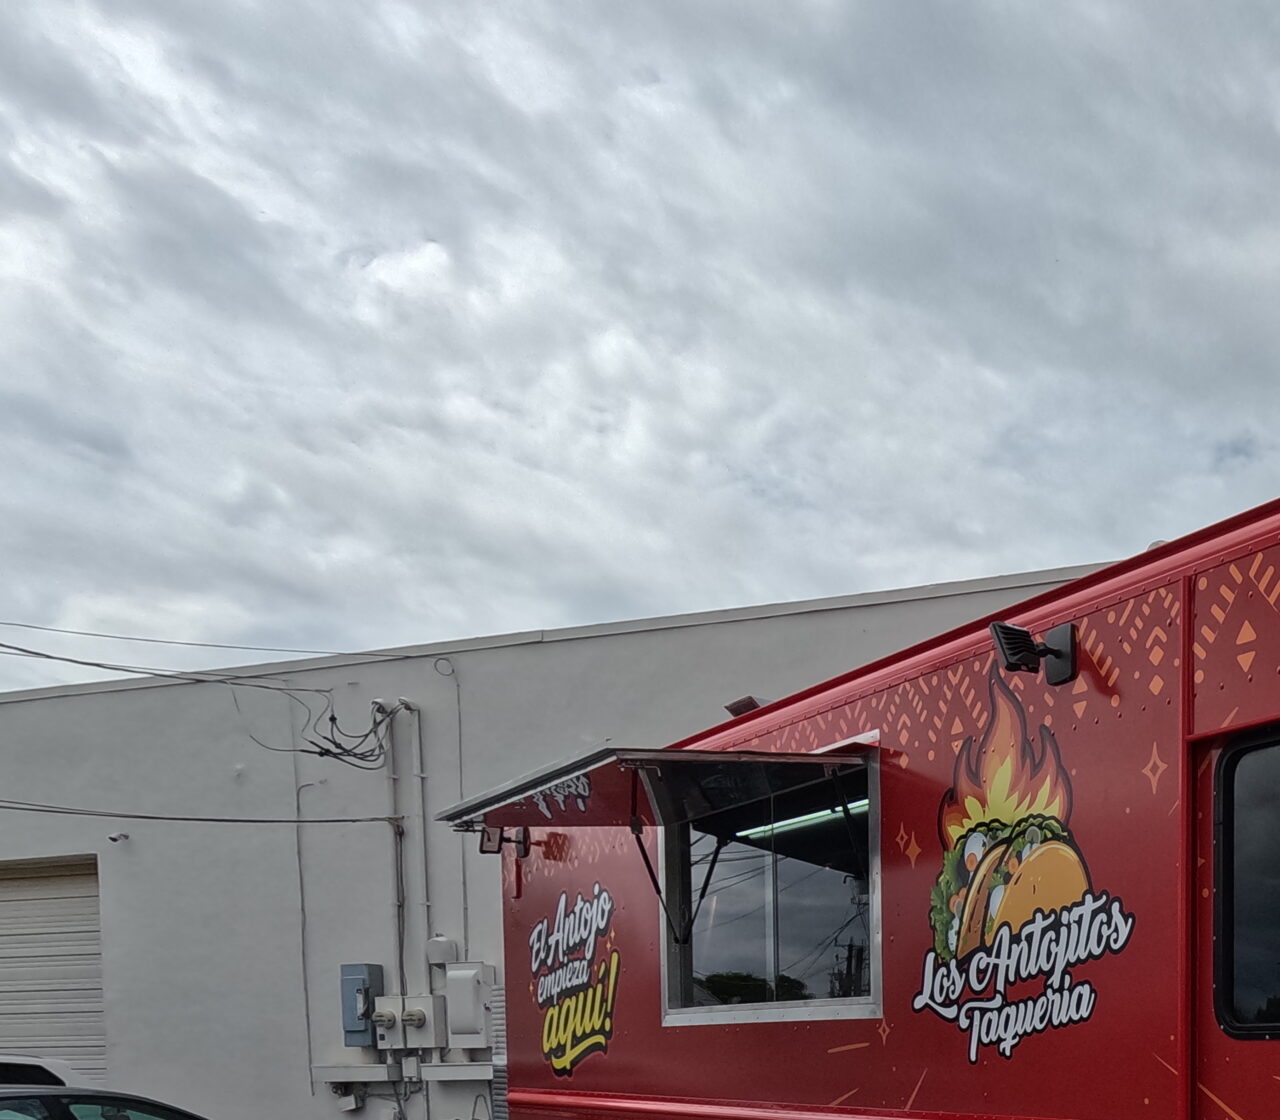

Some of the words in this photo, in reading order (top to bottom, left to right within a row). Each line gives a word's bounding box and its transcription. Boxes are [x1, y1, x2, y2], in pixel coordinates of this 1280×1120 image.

[529, 918, 548, 973] El
[547, 882, 612, 962] Antojo
[913, 951, 965, 1019] Los
[968, 893, 1133, 993] Antojitos
[537, 955, 590, 1005] empieza
[543, 951, 620, 1070] aquí!
[959, 974, 1096, 1062] Taqueria
